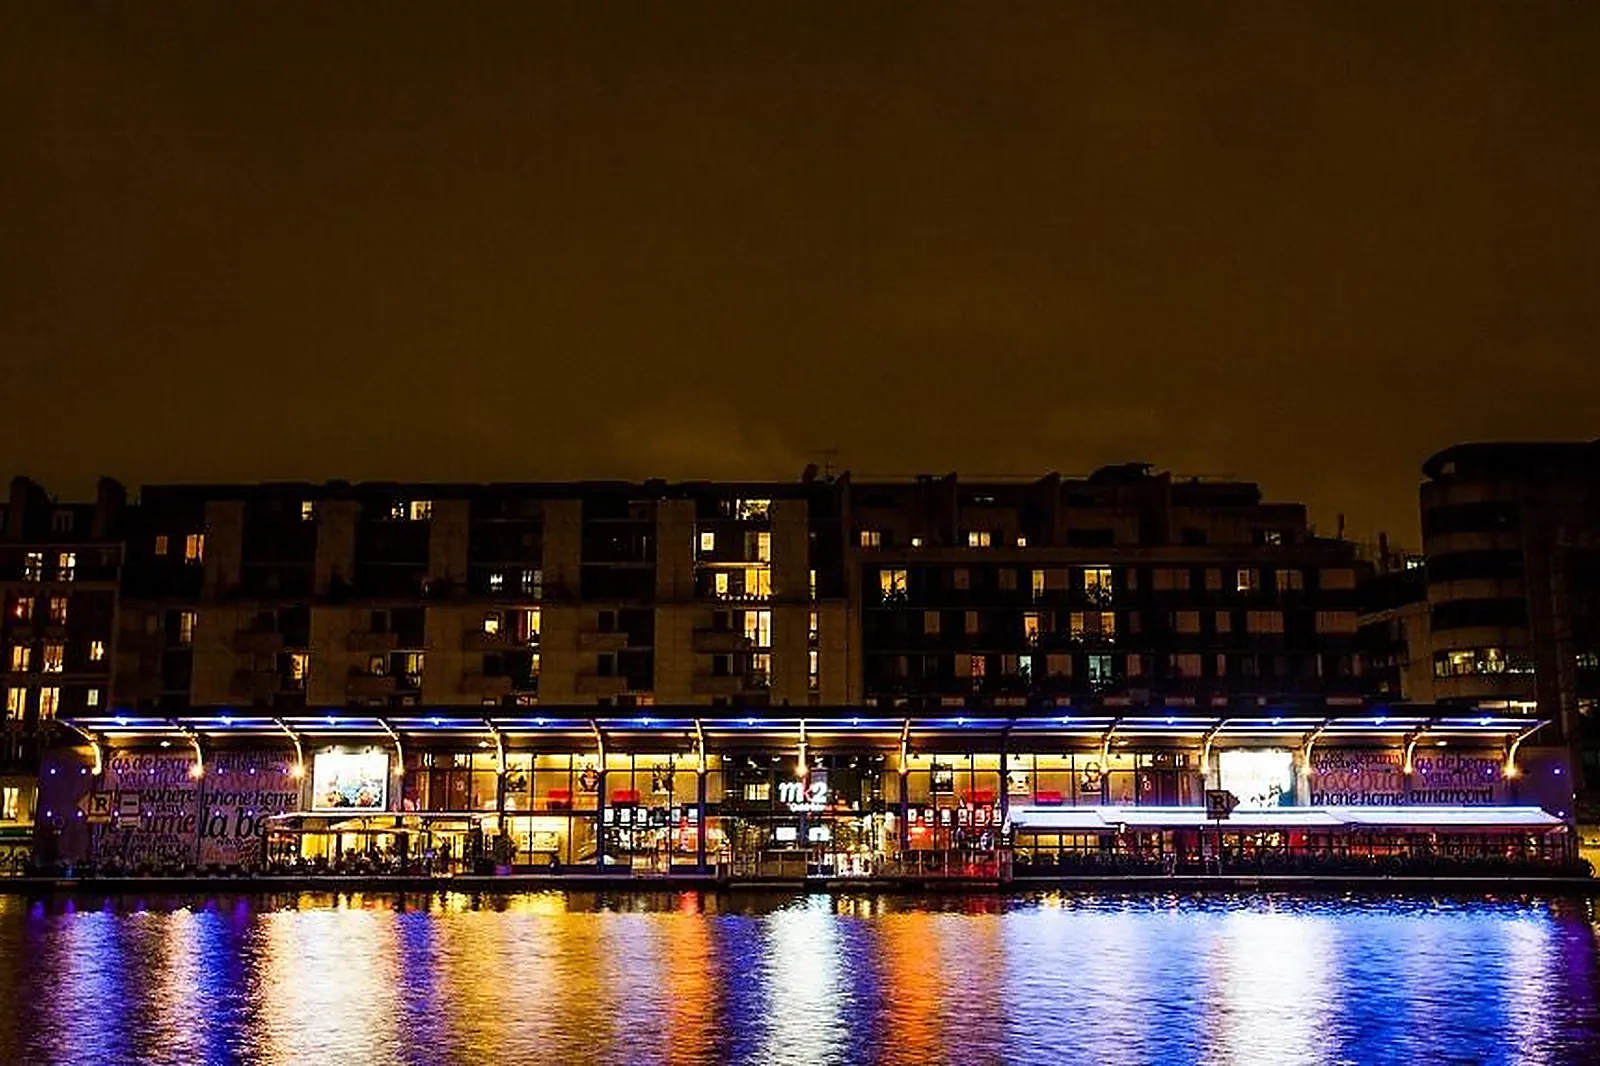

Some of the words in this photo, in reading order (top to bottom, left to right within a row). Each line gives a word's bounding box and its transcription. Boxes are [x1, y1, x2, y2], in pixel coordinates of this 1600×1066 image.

[204, 788, 253, 806] phone
[254, 788, 298, 806] home
[779, 776, 828, 804] mk2
[1310, 789, 1359, 806] phone
[1361, 789, 1405, 806] home
